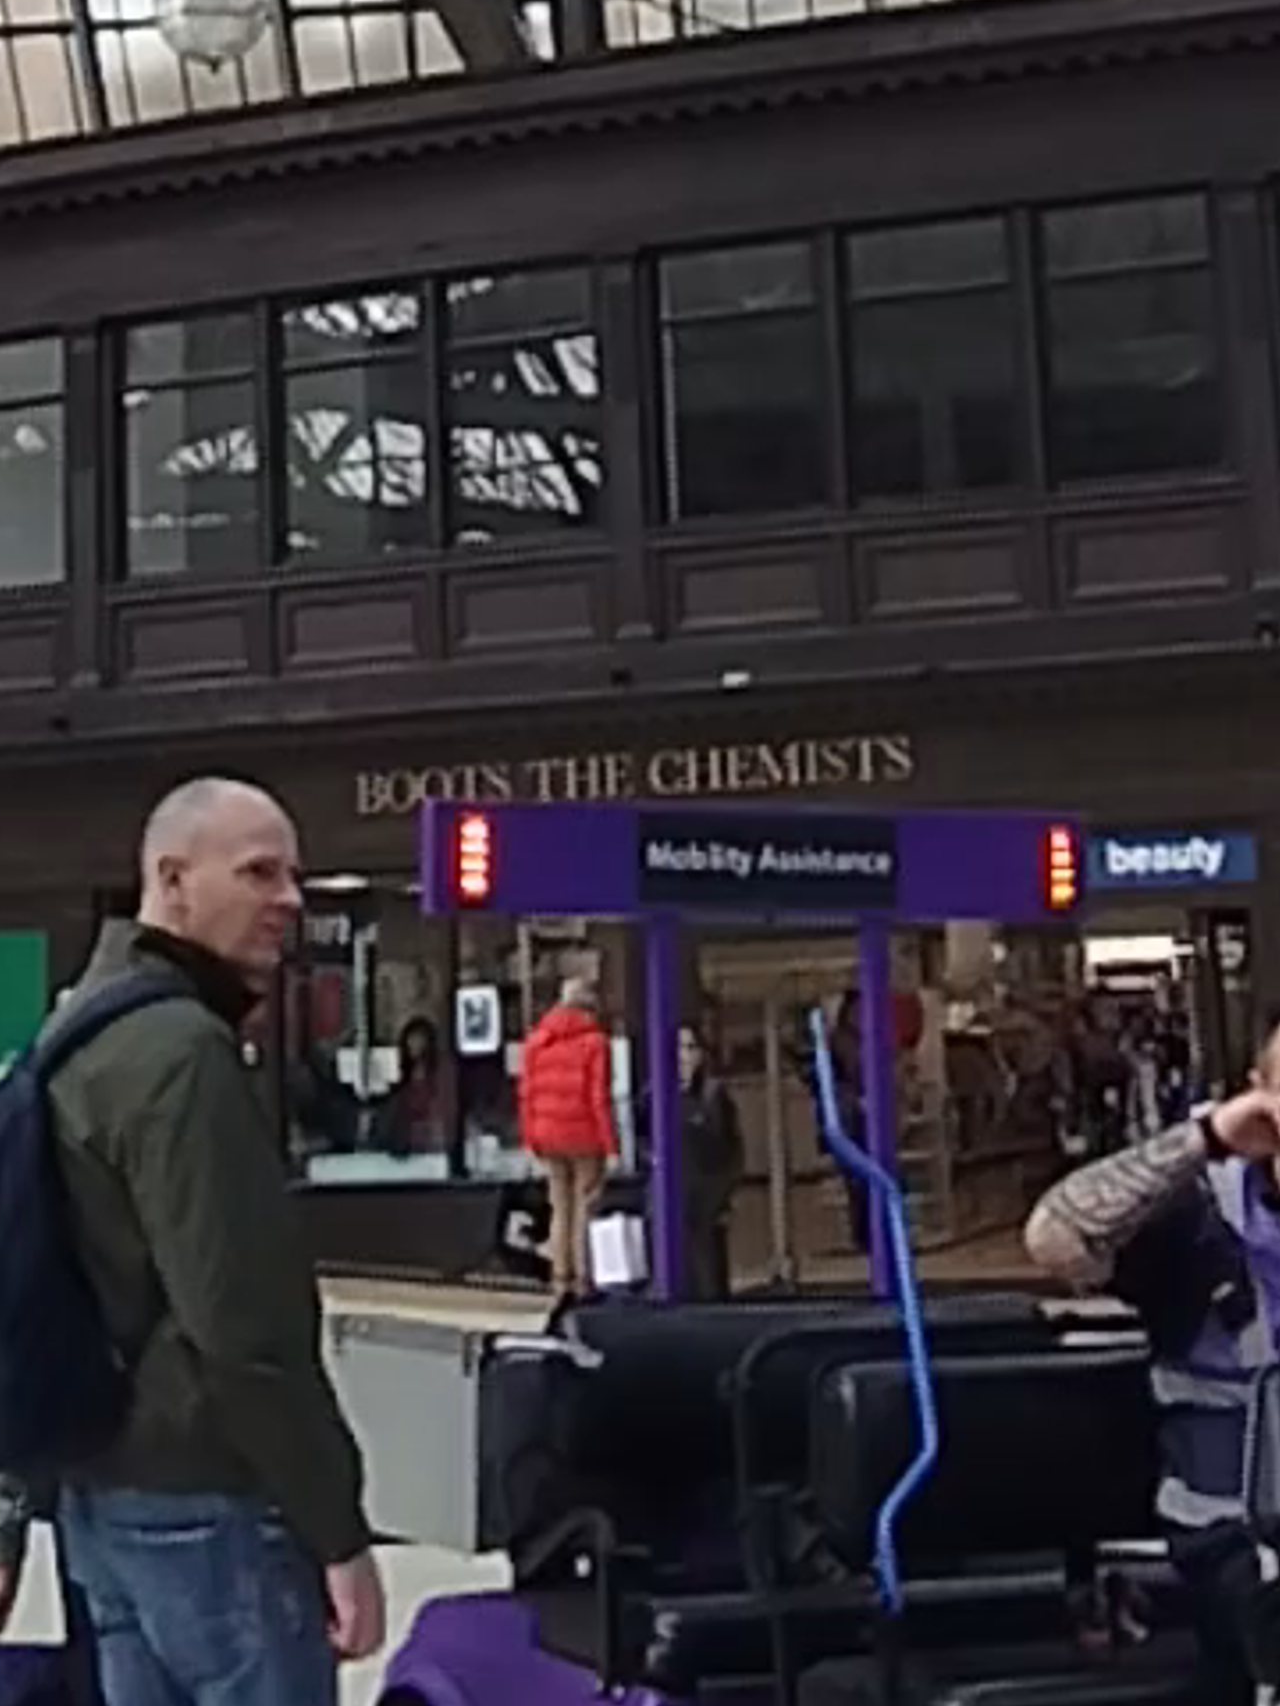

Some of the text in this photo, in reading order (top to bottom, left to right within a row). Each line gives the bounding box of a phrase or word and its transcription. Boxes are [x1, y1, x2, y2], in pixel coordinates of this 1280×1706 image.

[354, 734, 914, 815] BOOTS THE CHEMISTS
[646, 840, 891, 877] Mobility Assistance
[1104, 831, 1225, 876] beauty
